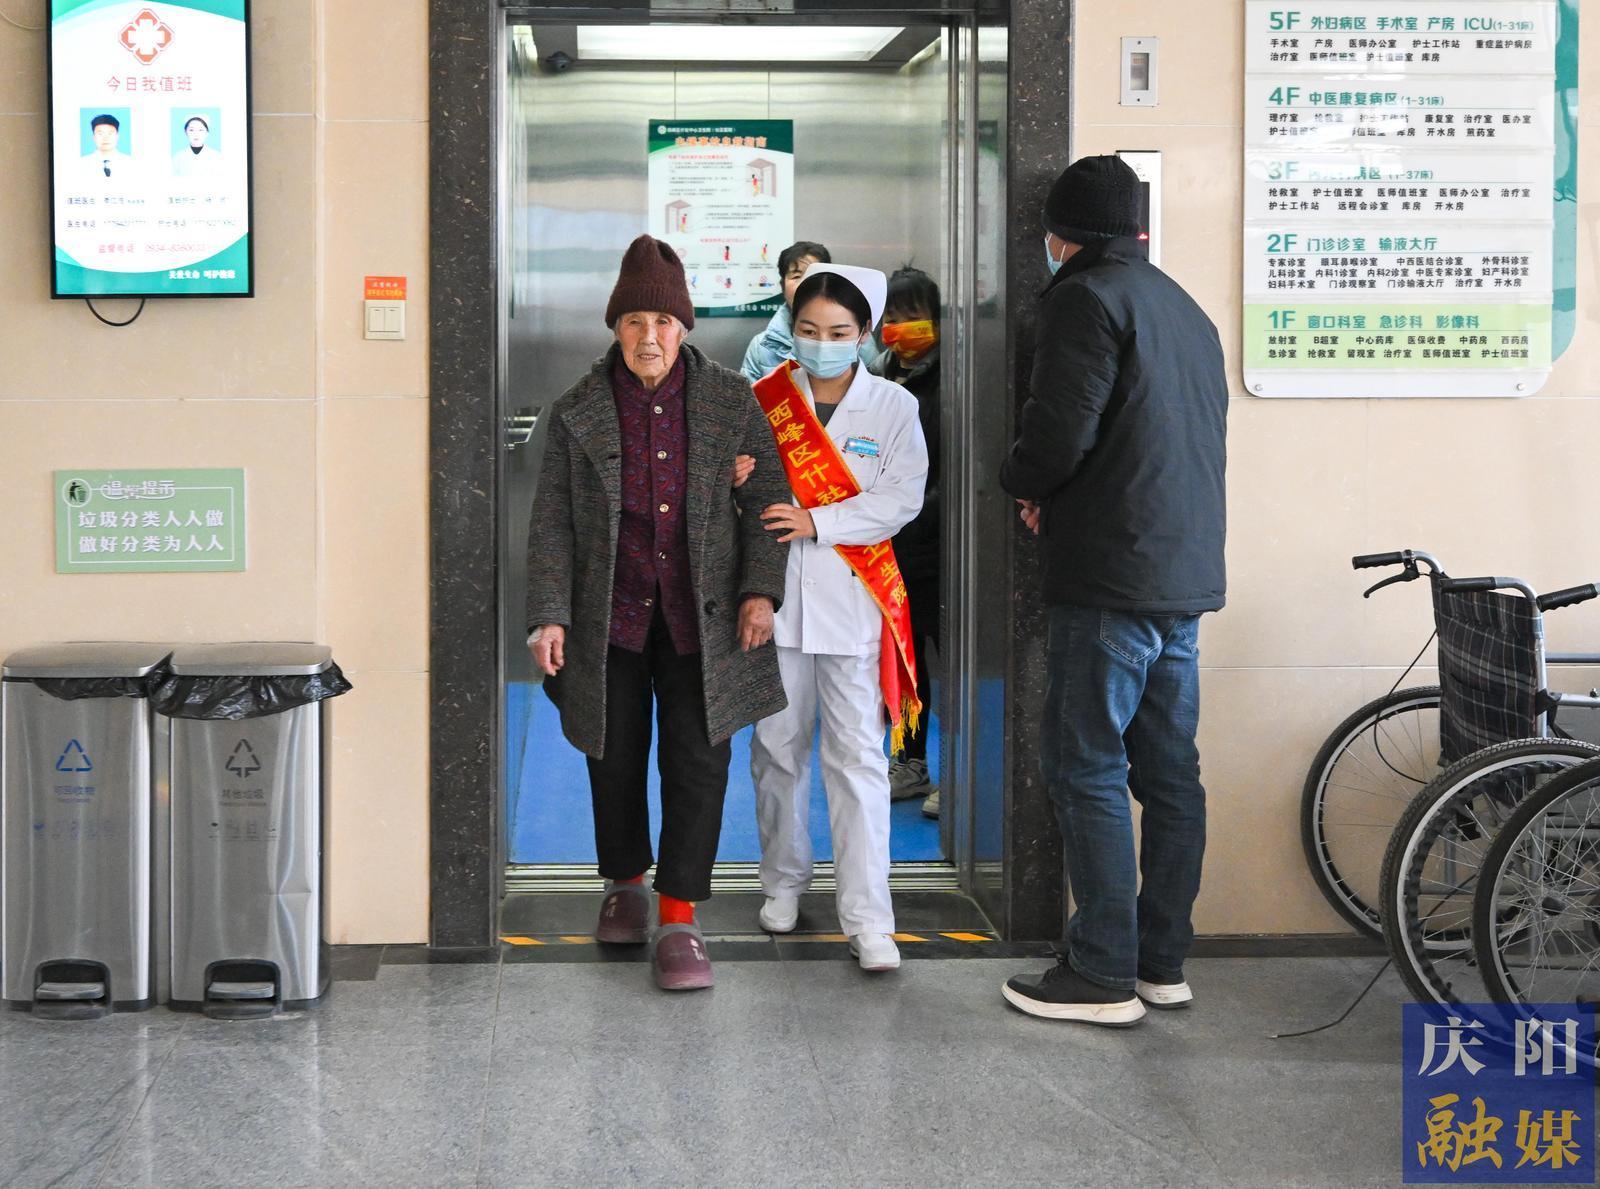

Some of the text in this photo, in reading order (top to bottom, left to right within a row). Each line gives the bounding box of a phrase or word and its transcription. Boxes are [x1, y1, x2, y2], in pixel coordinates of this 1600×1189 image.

[1270, 12, 1301, 31] 5F
[1311, 16, 1366, 31] 外妇病区
[1376, 16, 1418, 31] 手术室
[1428, 16, 1456, 31] 产房
[1269, 38, 1532, 48] 手术室 产房 医师办公室 护士工作站 重症监护病房
[1269, 52, 1299, 62] 治疗室
[1421, 52, 1441, 62] 库房
[107, 76, 192, 92] 今日我值班
[1268, 87, 1300, 105] 4F
[1268, 112, 1298, 122] 理疗室
[1424, 113, 1454, 123] 康复室
[1463, 113, 1493, 123] 治疗室
[1501, 114, 1532, 123] 医办室
[1426, 127, 1455, 136] 开水房
[1466, 127, 1496, 136] 煎药室
[1268, 161, 1300, 180] 3F
[1268, 187, 1531, 197] 抢救室 护士值班室 医师值班室 医师办公室 治疗室
[1268, 201, 1465, 211] 护士工作站 远程会诊室 库房 开水房
[1267, 234, 1438, 252] 2F 门诊诊室 输液大厅
[1268, 257, 1306, 267] 专家诊室
[1321, 257, 1379, 267] 眼耳鼻喉诊室
[1397, 256, 1463, 266] 中西医结合诊室
[1268, 267, 1528, 278] 儿科诊室 内科1诊室 内科2诊室 中医专家诊室 妇产科诊室
[1268, 278, 1522, 289] 妇科手术室 门诊观察室 门诊输液大厅 治疗室 开水房
[1268, 311, 1480, 328] 1F 窗口科室 急诊科 影像科
[1268, 335, 1529, 345] 放射室 B超室 中心药库 医保收费 中药房 西药房
[1268, 348, 1529, 359] 急诊室 抢救室 留观室 治疗室 医师值班室 护士值班室
[78, 510, 224, 529] 垃圾分类人人做
[79, 534, 225, 554] 做好分类为人人
